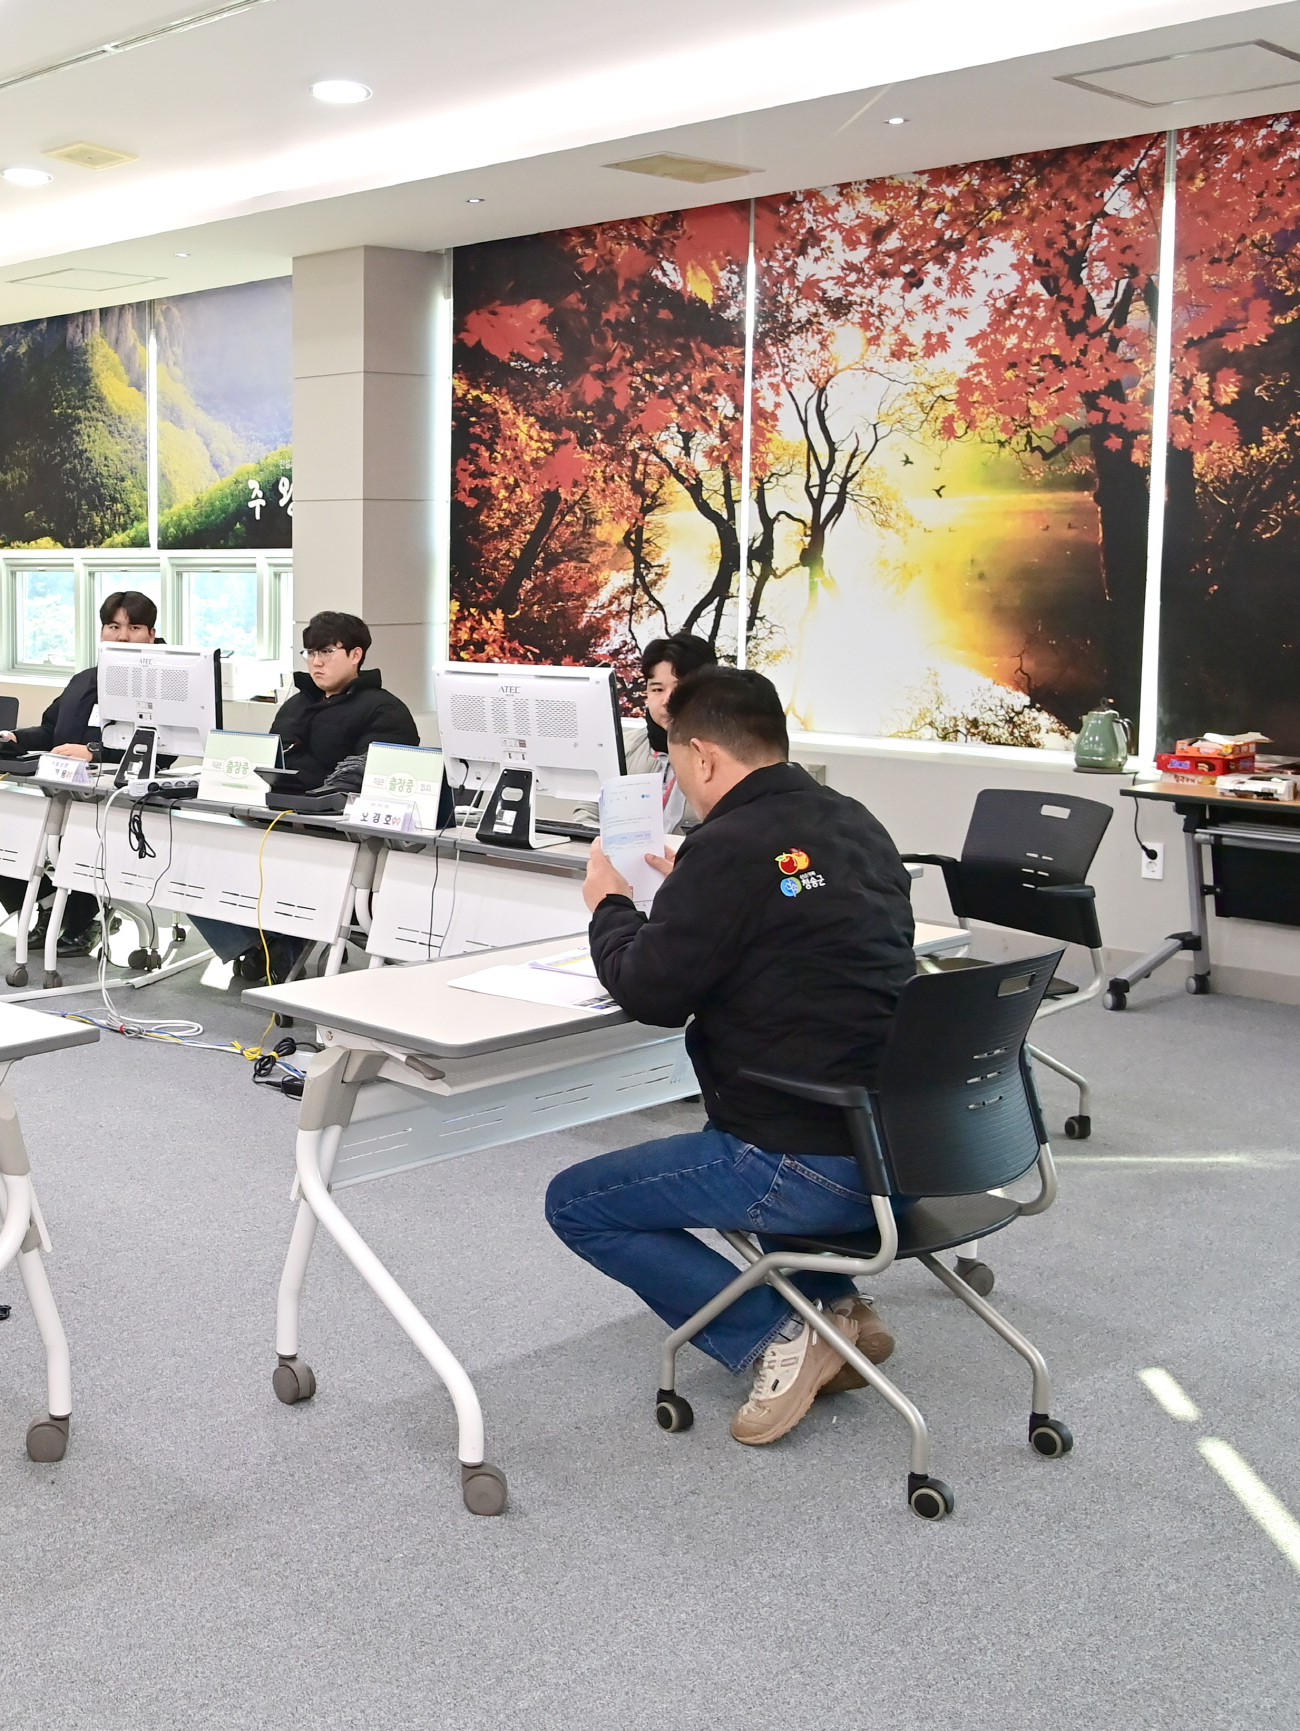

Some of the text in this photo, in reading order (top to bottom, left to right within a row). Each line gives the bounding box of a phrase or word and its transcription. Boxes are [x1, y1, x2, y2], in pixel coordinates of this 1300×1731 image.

[498, 685, 521, 694] ATEC
[226, 760, 250, 775] 출장중
[389, 776, 414, 794] 출장중
